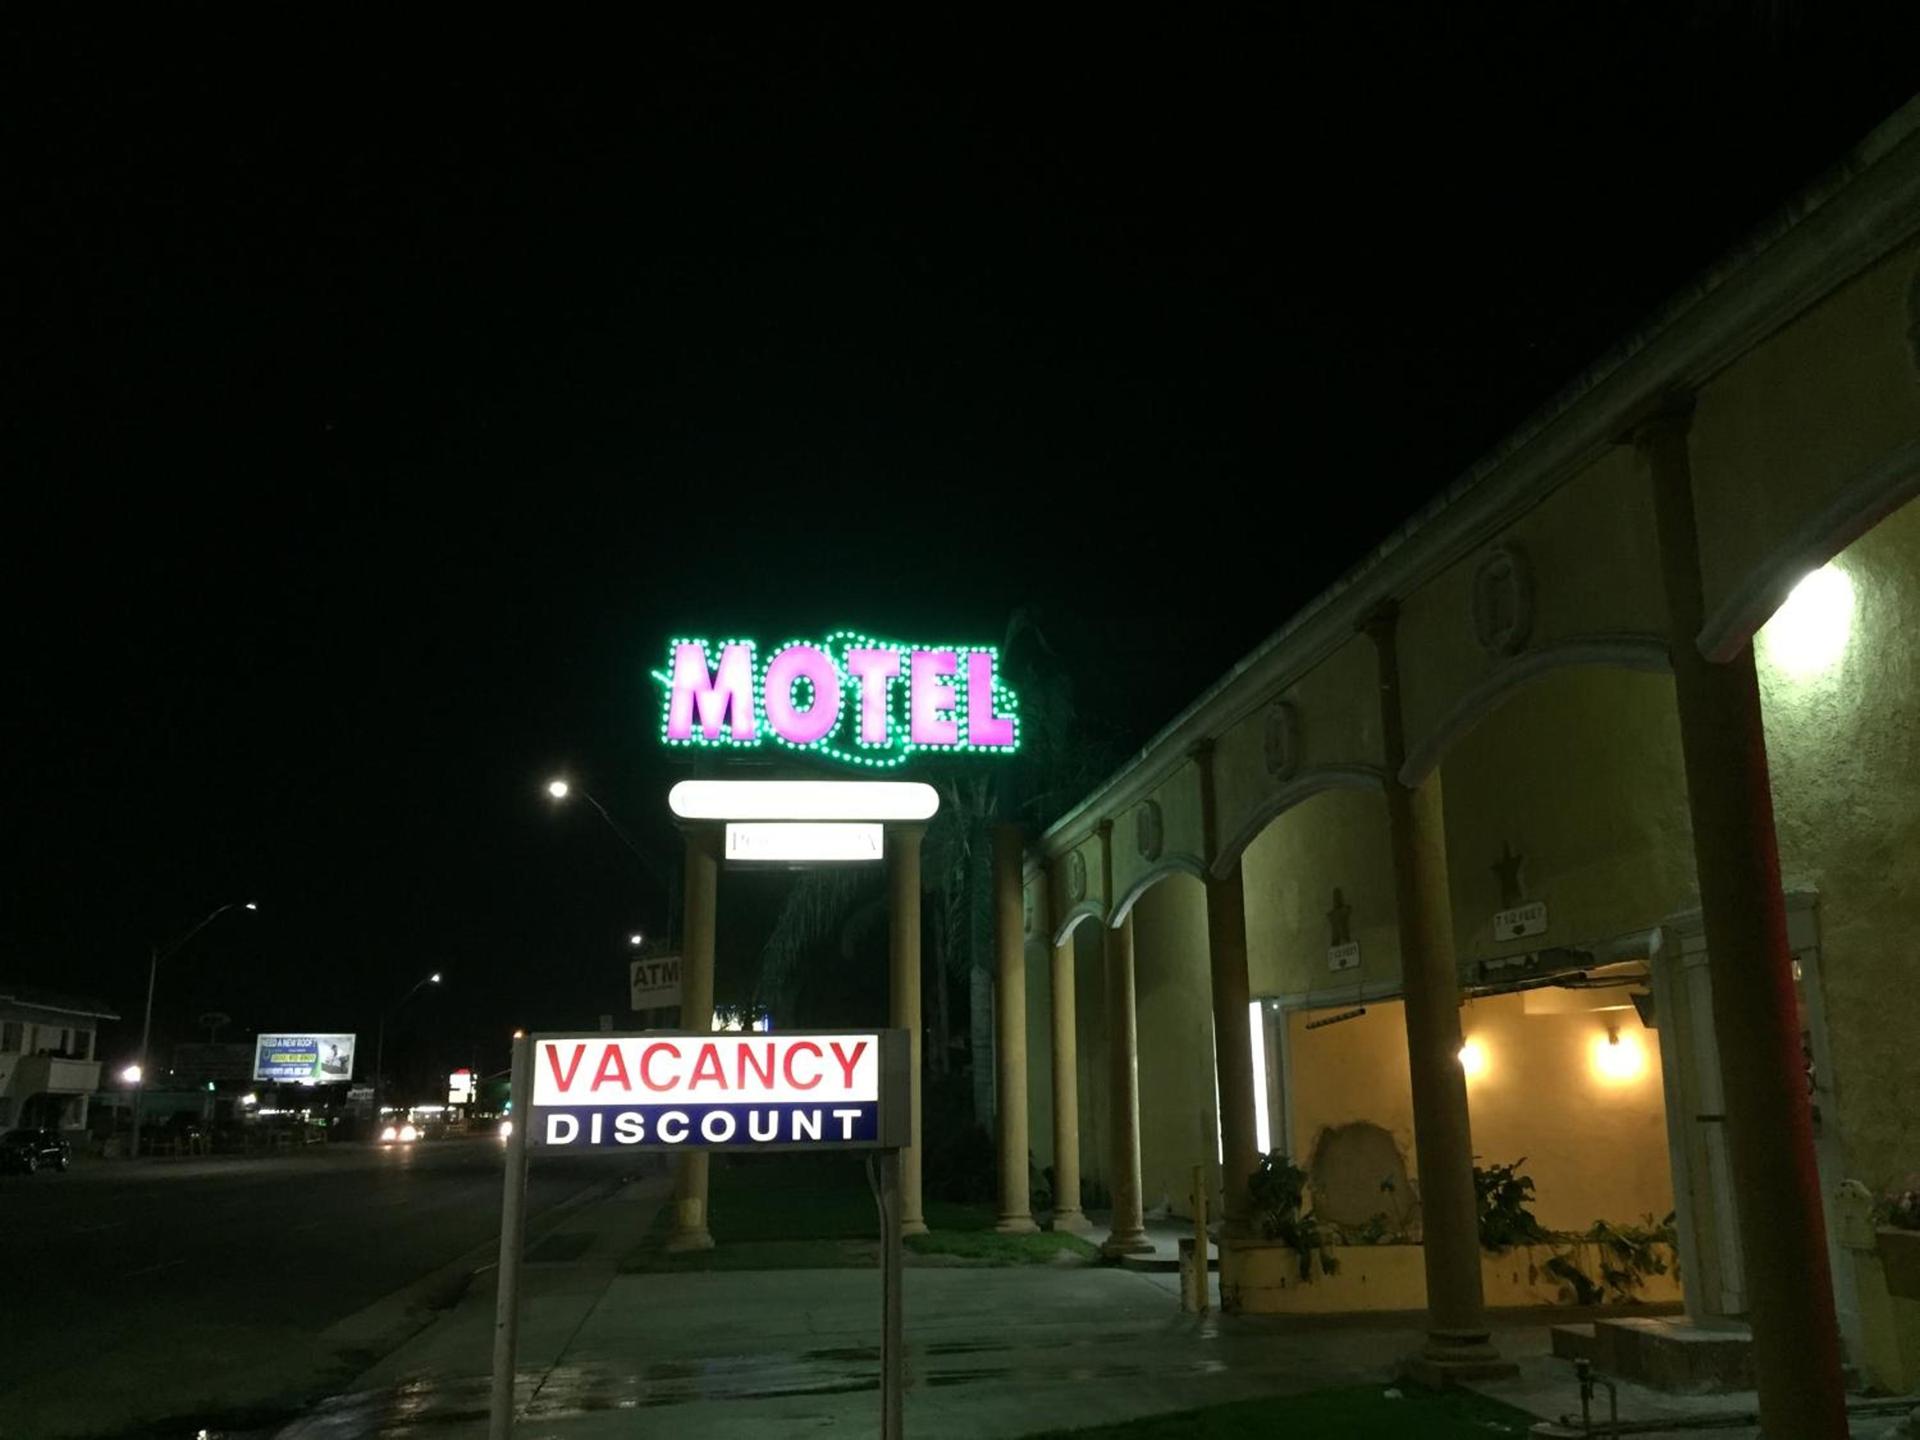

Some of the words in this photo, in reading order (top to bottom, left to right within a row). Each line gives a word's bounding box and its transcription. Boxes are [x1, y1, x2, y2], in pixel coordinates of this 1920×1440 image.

[667, 643, 1014, 746] MOTEL
[633, 959, 679, 987] ATM
[545, 1041, 868, 1092] VACANCY
[545, 1109, 863, 1145] DISCOUNT
